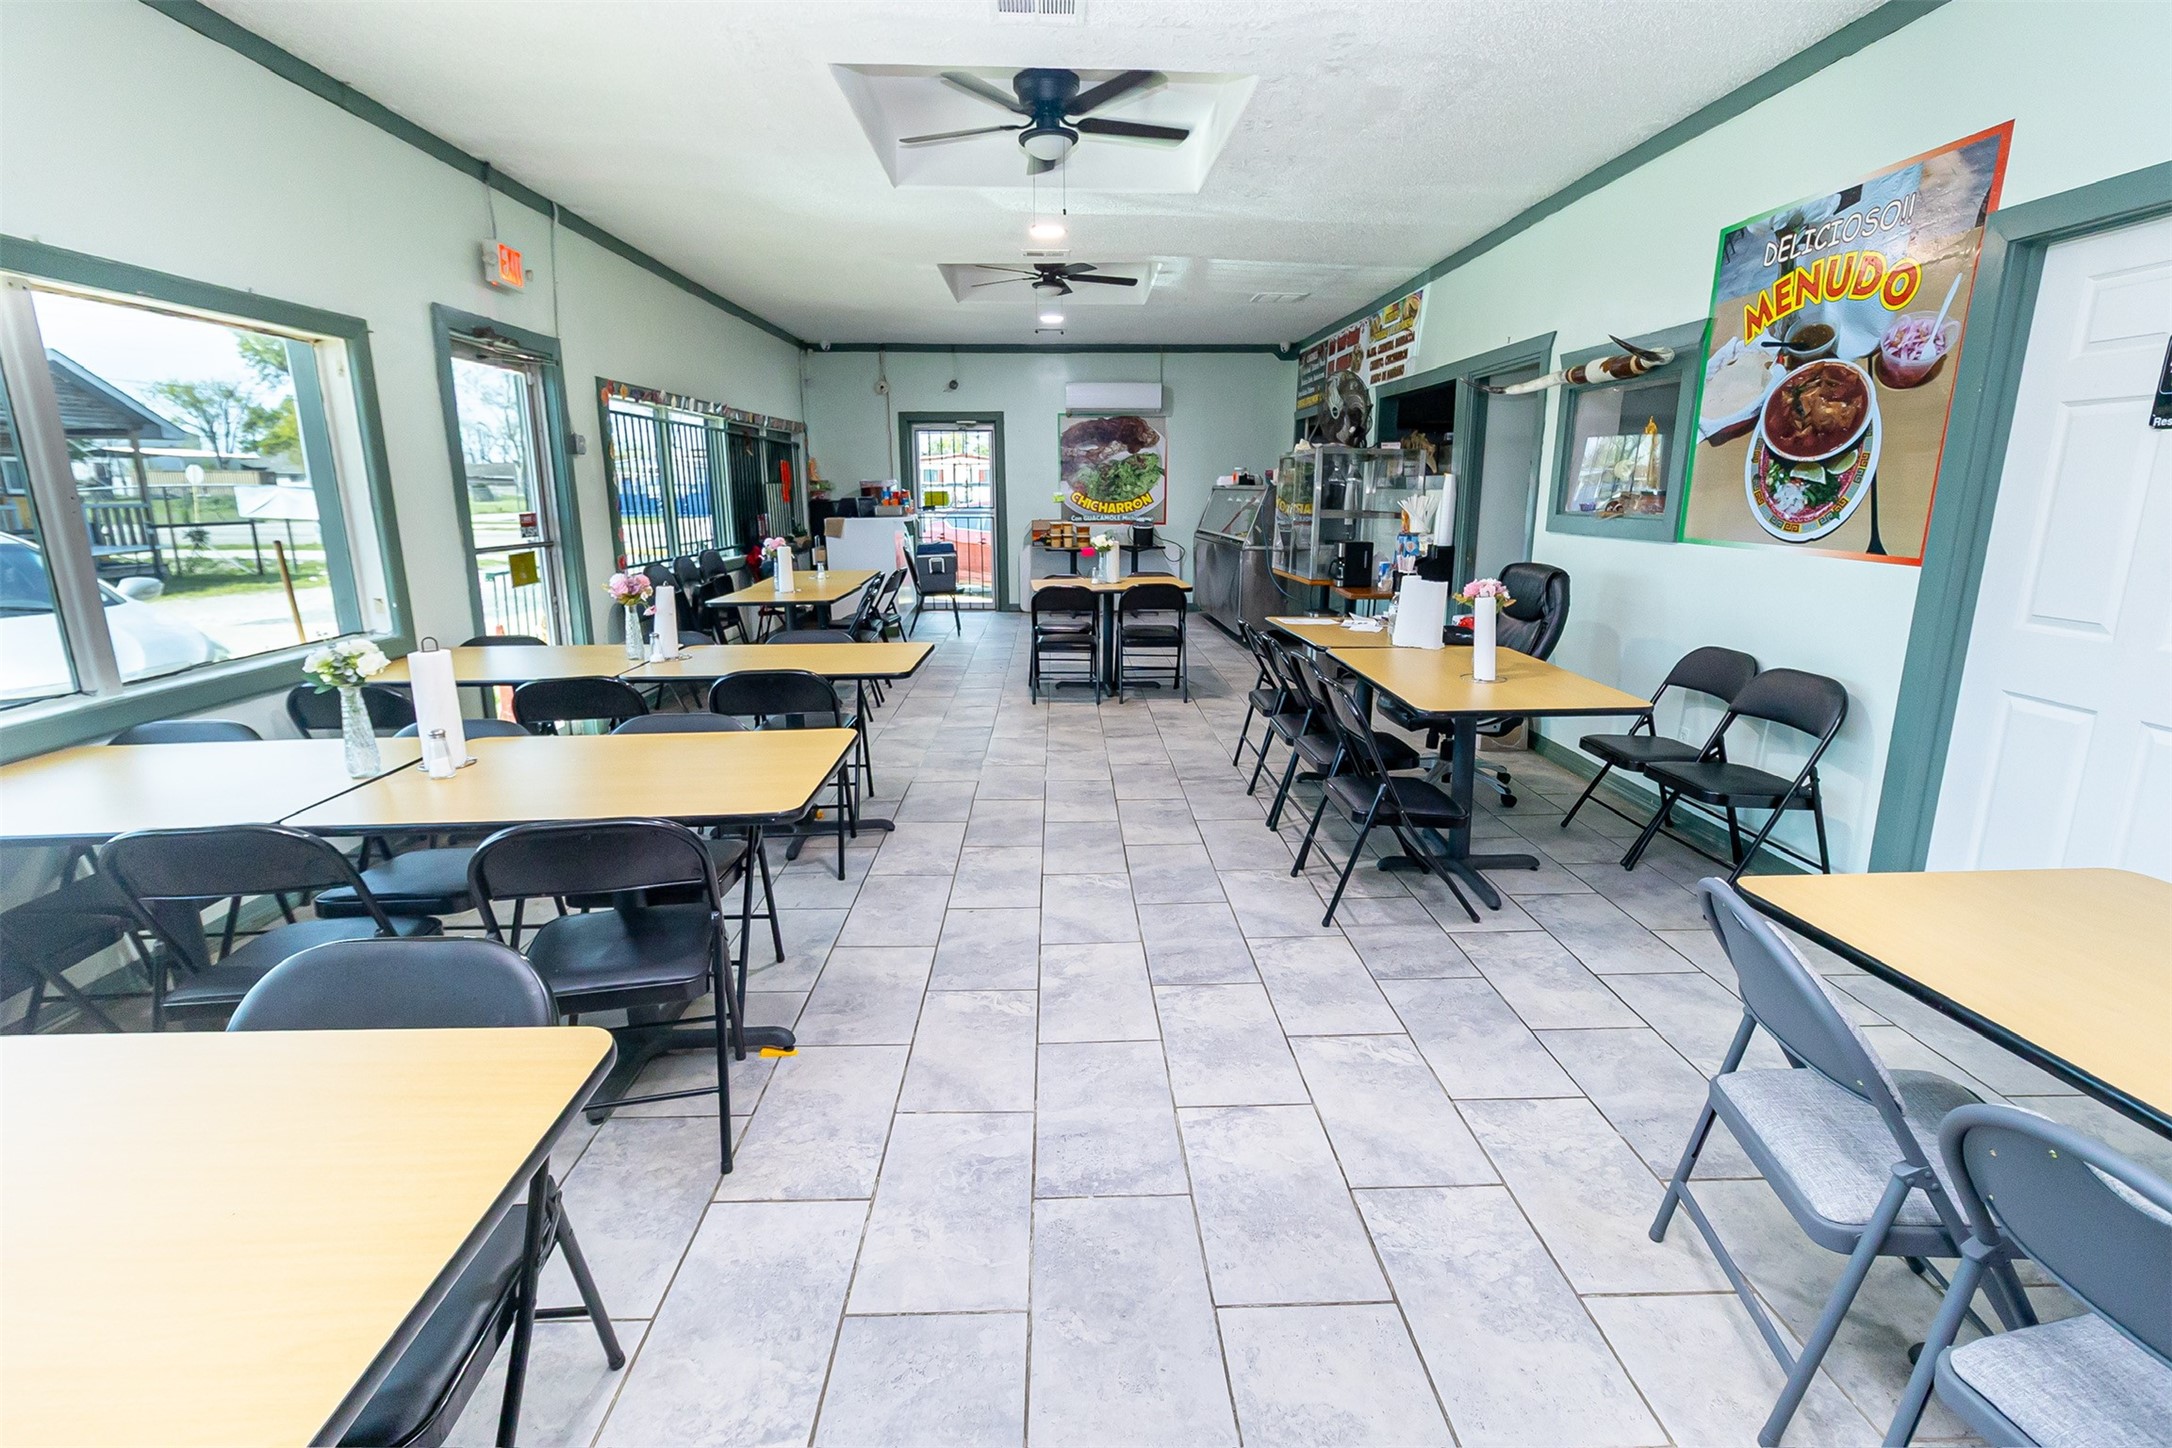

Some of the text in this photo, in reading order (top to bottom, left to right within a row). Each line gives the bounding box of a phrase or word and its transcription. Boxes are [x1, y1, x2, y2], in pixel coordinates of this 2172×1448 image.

[1763, 193, 1916, 267] DELICIOSO!!
[1744, 251, 1922, 346] MENUDO
[1070, 492, 1154, 514] CHICHARRON
